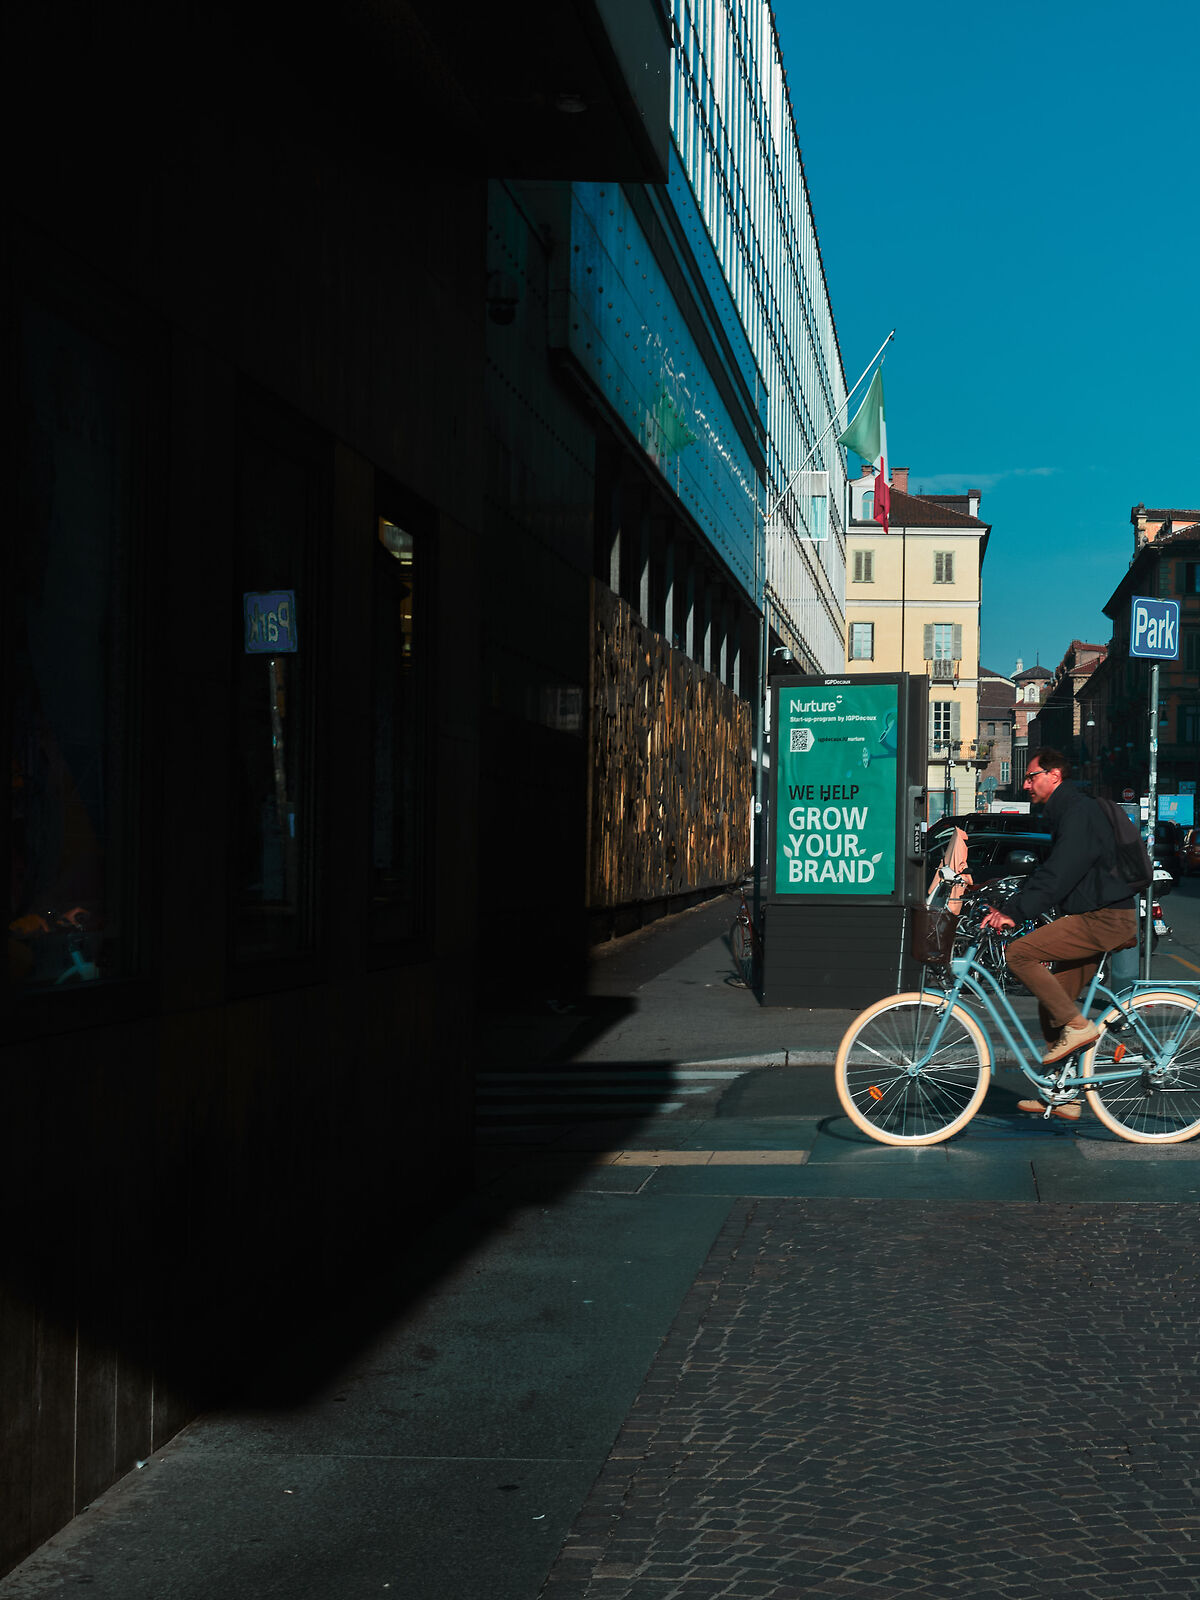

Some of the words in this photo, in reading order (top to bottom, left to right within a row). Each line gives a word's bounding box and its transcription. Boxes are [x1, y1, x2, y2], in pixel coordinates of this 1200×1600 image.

[1135, 607, 1175, 650] Park
[789, 699, 837, 713] Nurture
[788, 784, 814, 800] WE
[820, 784, 859, 800] HELP
[788, 806, 869, 830] GROW
[788, 833, 860, 857] YOUR
[788, 859, 875, 883] BRAND
